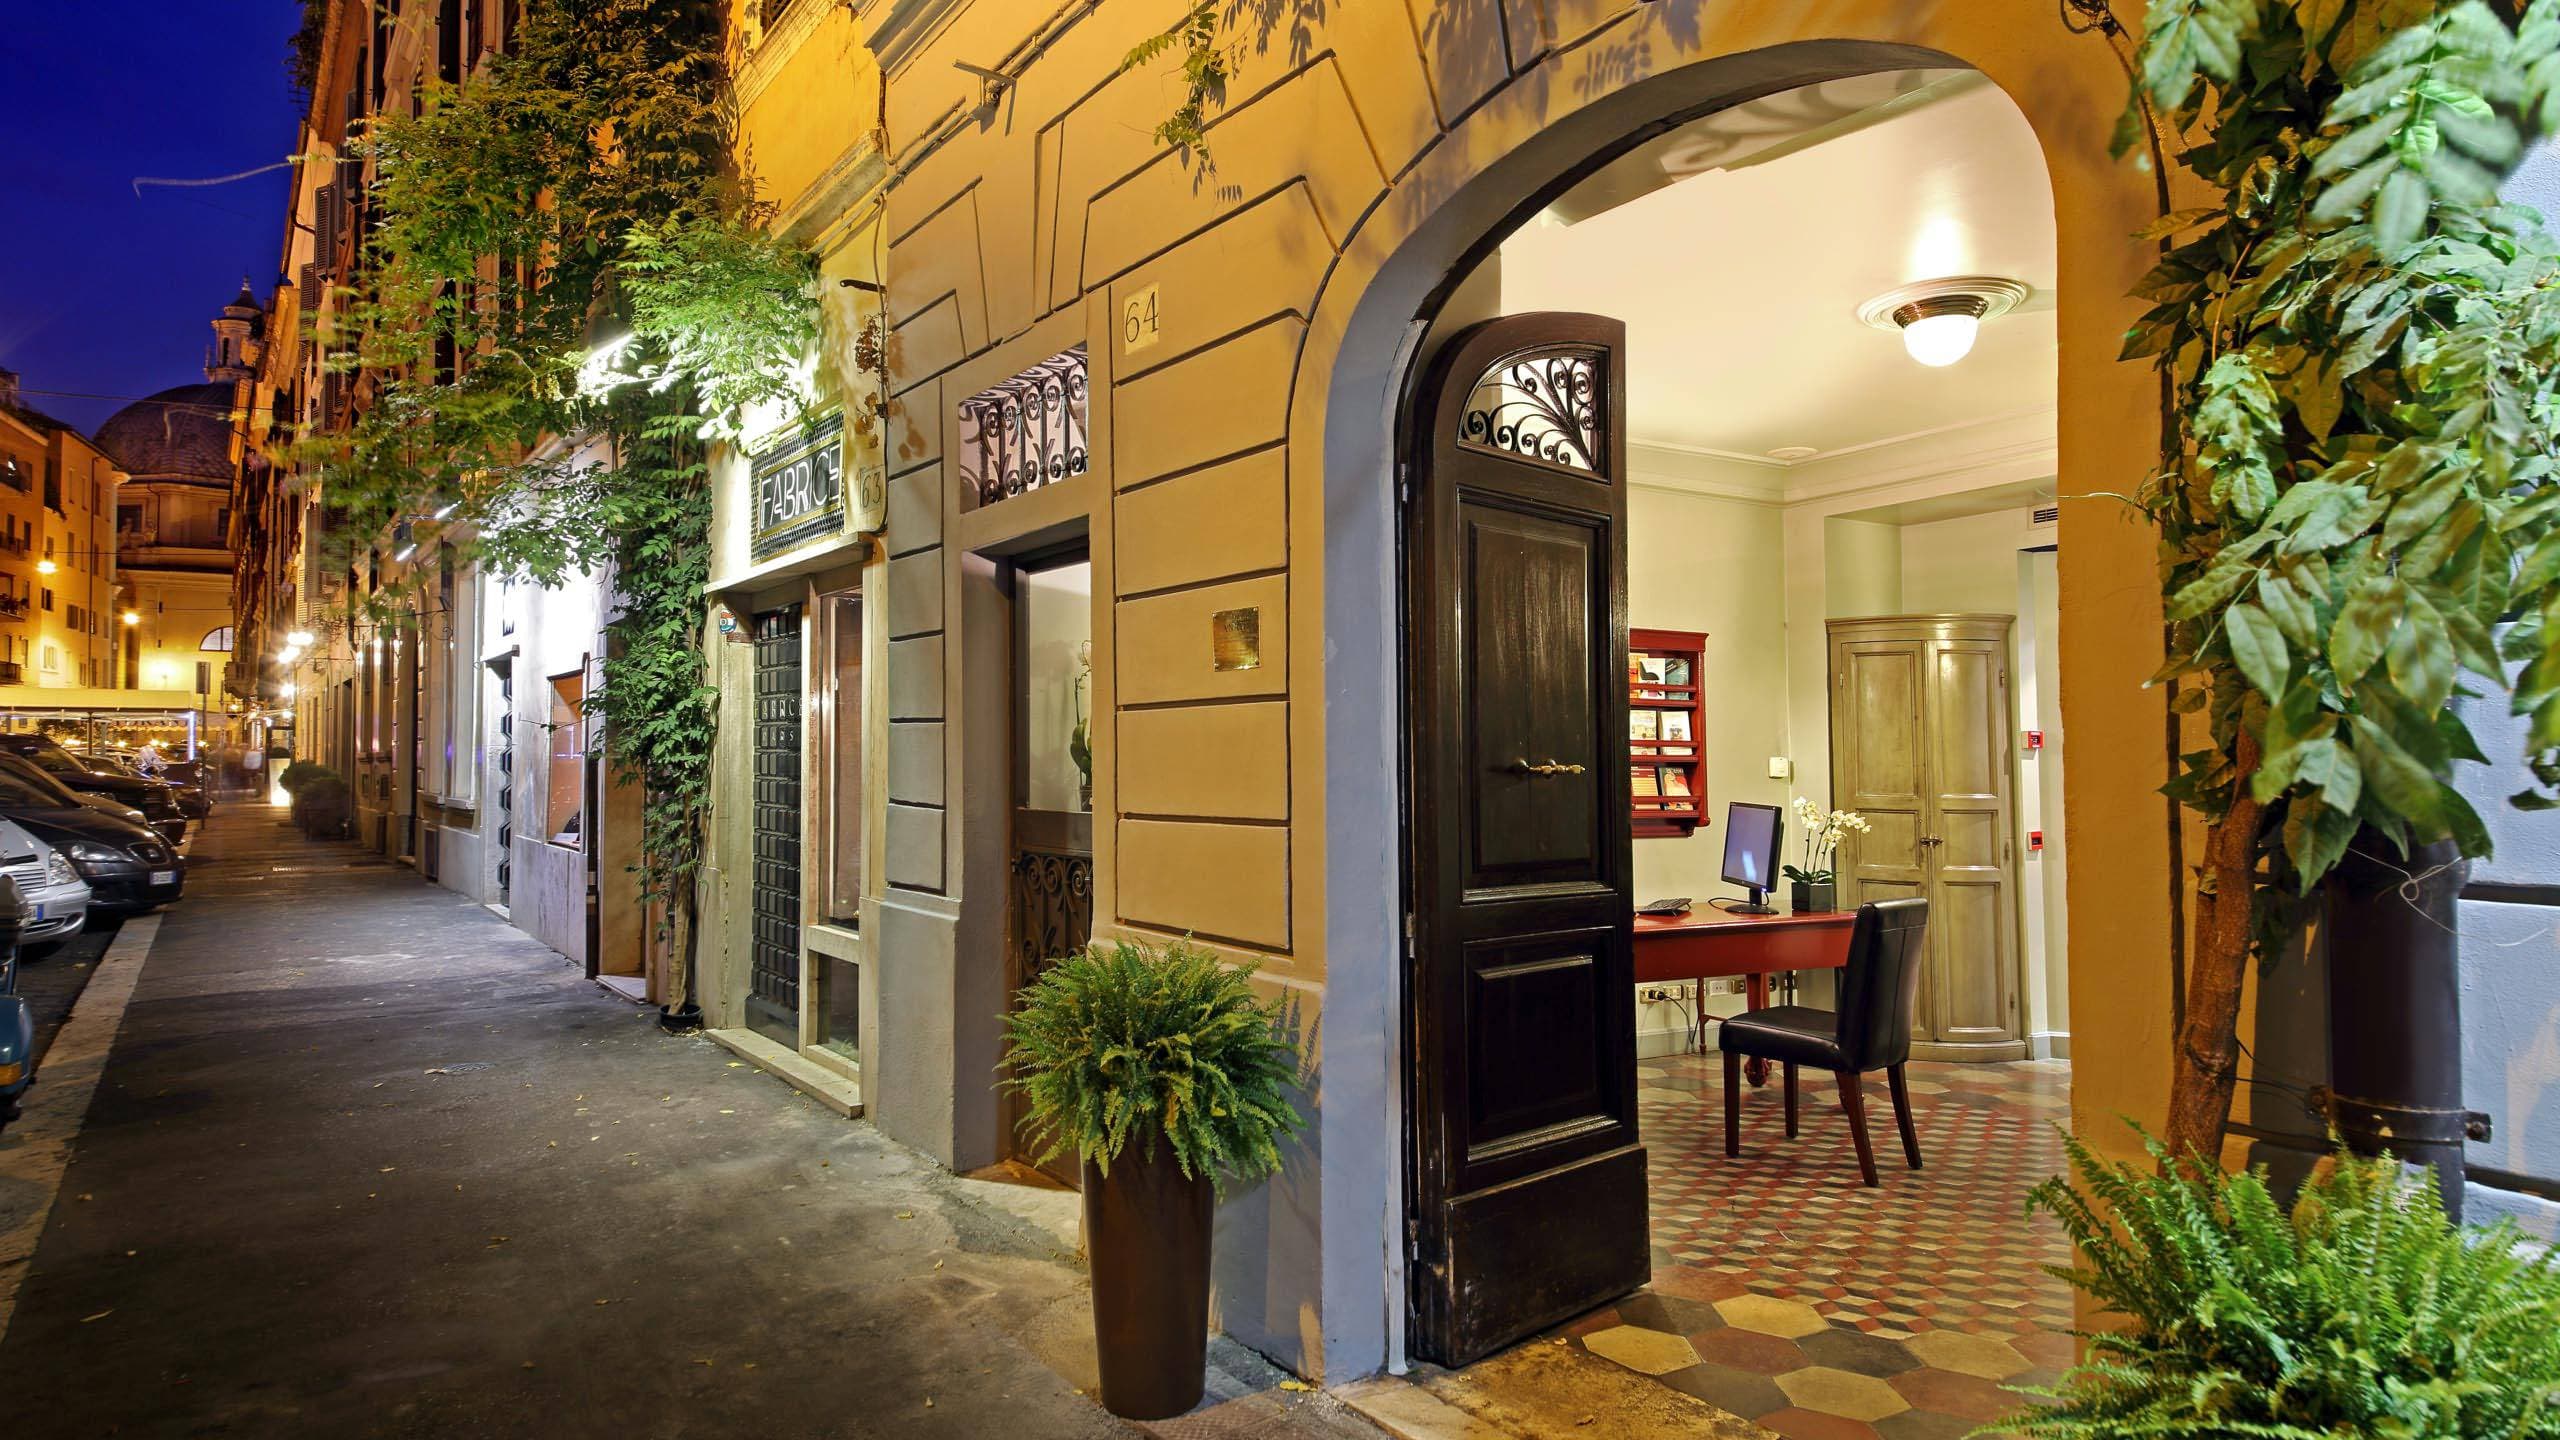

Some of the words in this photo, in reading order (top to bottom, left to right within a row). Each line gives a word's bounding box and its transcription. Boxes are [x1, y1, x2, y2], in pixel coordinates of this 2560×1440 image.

[1125, 291, 1159, 343] 64
[760, 443, 841, 529] FABRICE
[862, 471, 881, 508] 63
